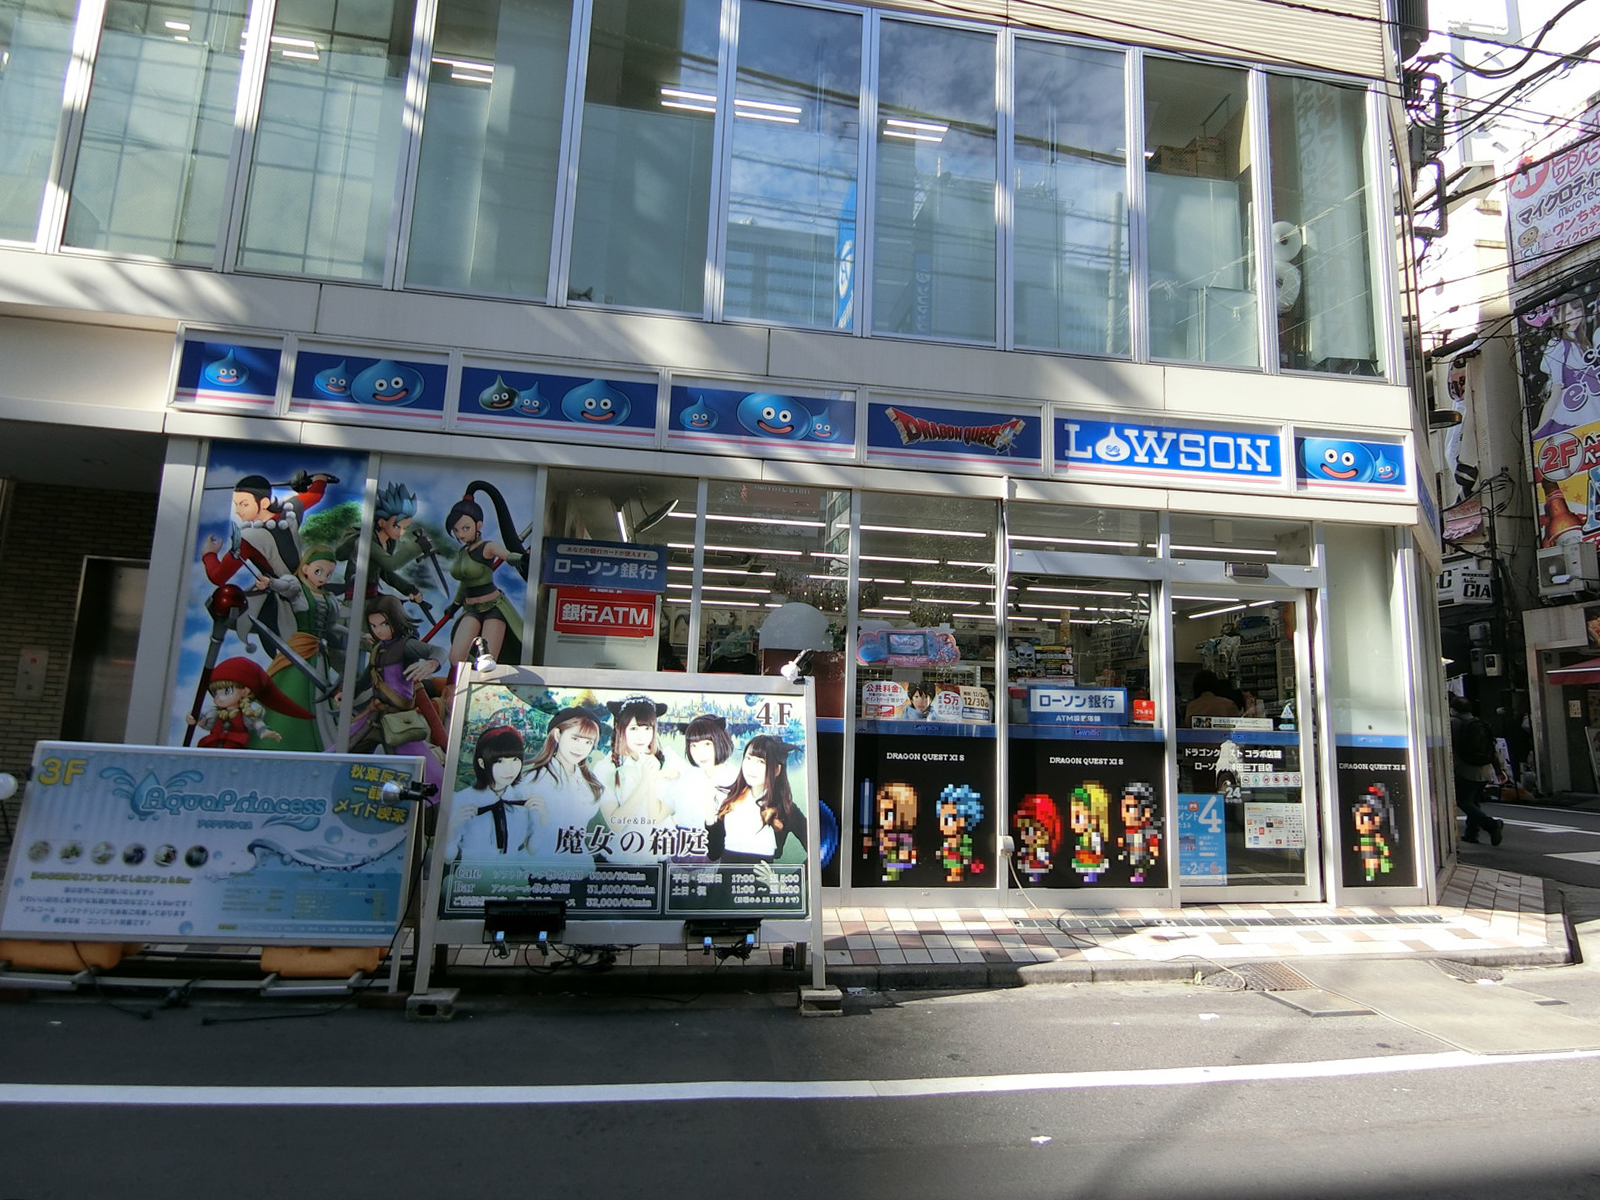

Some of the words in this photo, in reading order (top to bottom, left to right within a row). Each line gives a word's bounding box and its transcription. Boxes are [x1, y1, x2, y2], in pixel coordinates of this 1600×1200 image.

[885, 406, 963, 445] DRAGON
[1541, 439, 1578, 474] 2F
[554, 558, 658, 580] ローソン銀行
[562, 603, 649, 625] 銀行ATM
[866, 684, 899, 693] 公共料金
[1039, 694, 1115, 708] ローソン銀行
[755, 702, 793, 726] 4F
[886, 752, 921, 760] DRAGON
[921, 753, 948, 762] QUEST
[38, 758, 88, 786] 3F
[140, 786, 327, 816] AquaPrincess
[1226, 787, 1242, 798] 24
[334, 799, 408, 823] メイド喫茶
[610, 815, 656, 826] Cafe&Bar
[555, 826, 708, 858] 魔女の箱庭
[456, 868, 481, 879] Cafe
[453, 881, 475, 893] Bar
